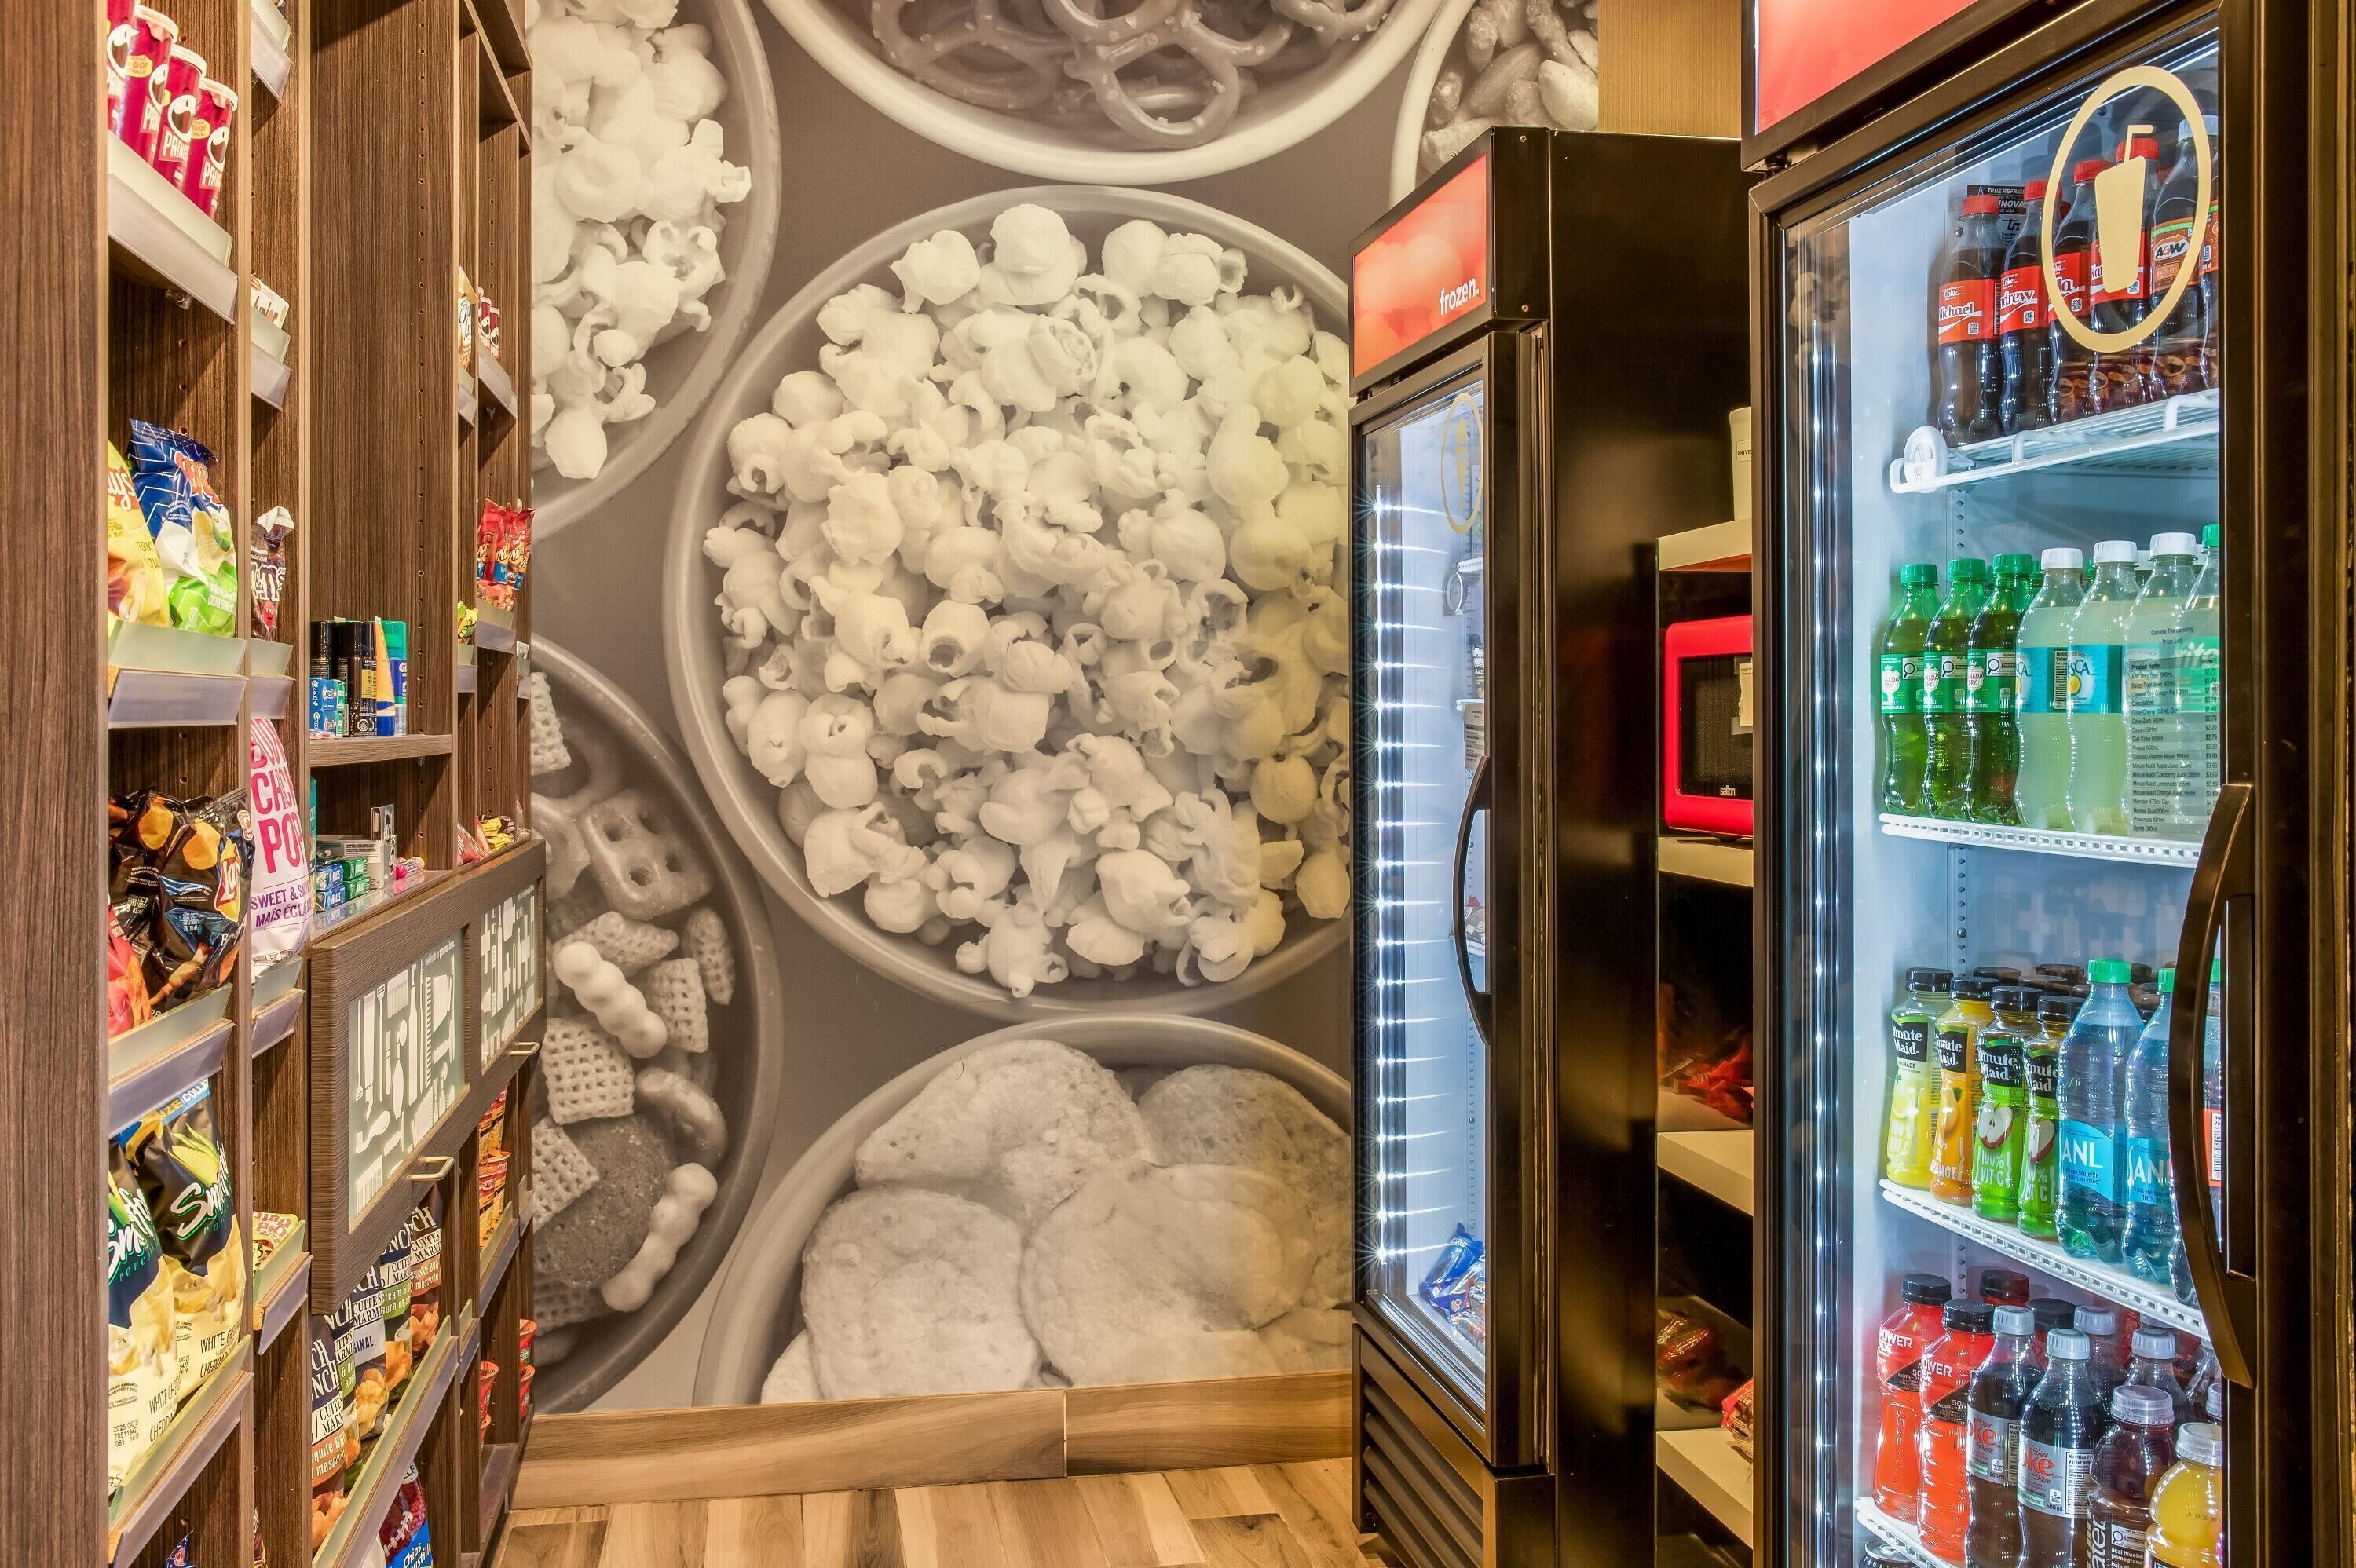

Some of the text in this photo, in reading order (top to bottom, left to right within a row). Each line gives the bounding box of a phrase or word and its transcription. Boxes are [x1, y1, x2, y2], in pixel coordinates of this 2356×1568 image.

[2155, 242, 2187, 258] A&W
[2002, 277, 2015, 287] Coke
[1440, 276, 1480, 317] frozen.
[1944, 289, 1959, 298] Coke
[1720, 784, 1736, 797] salton
[255, 908, 282, 928] MAÏS
[1981, 1148, 2005, 1169] 100%
[1980, 1166, 2004, 1186] VIT C
[200, 1331, 225, 1354] WHITE
[149, 1387, 168, 1415] WHITE
[113, 1424, 126, 1433] 2025
[126, 1420, 135, 1429] OC
[1977, 1419, 1992, 1428] Diet
[2033, 1447, 2049, 1459] Diet
